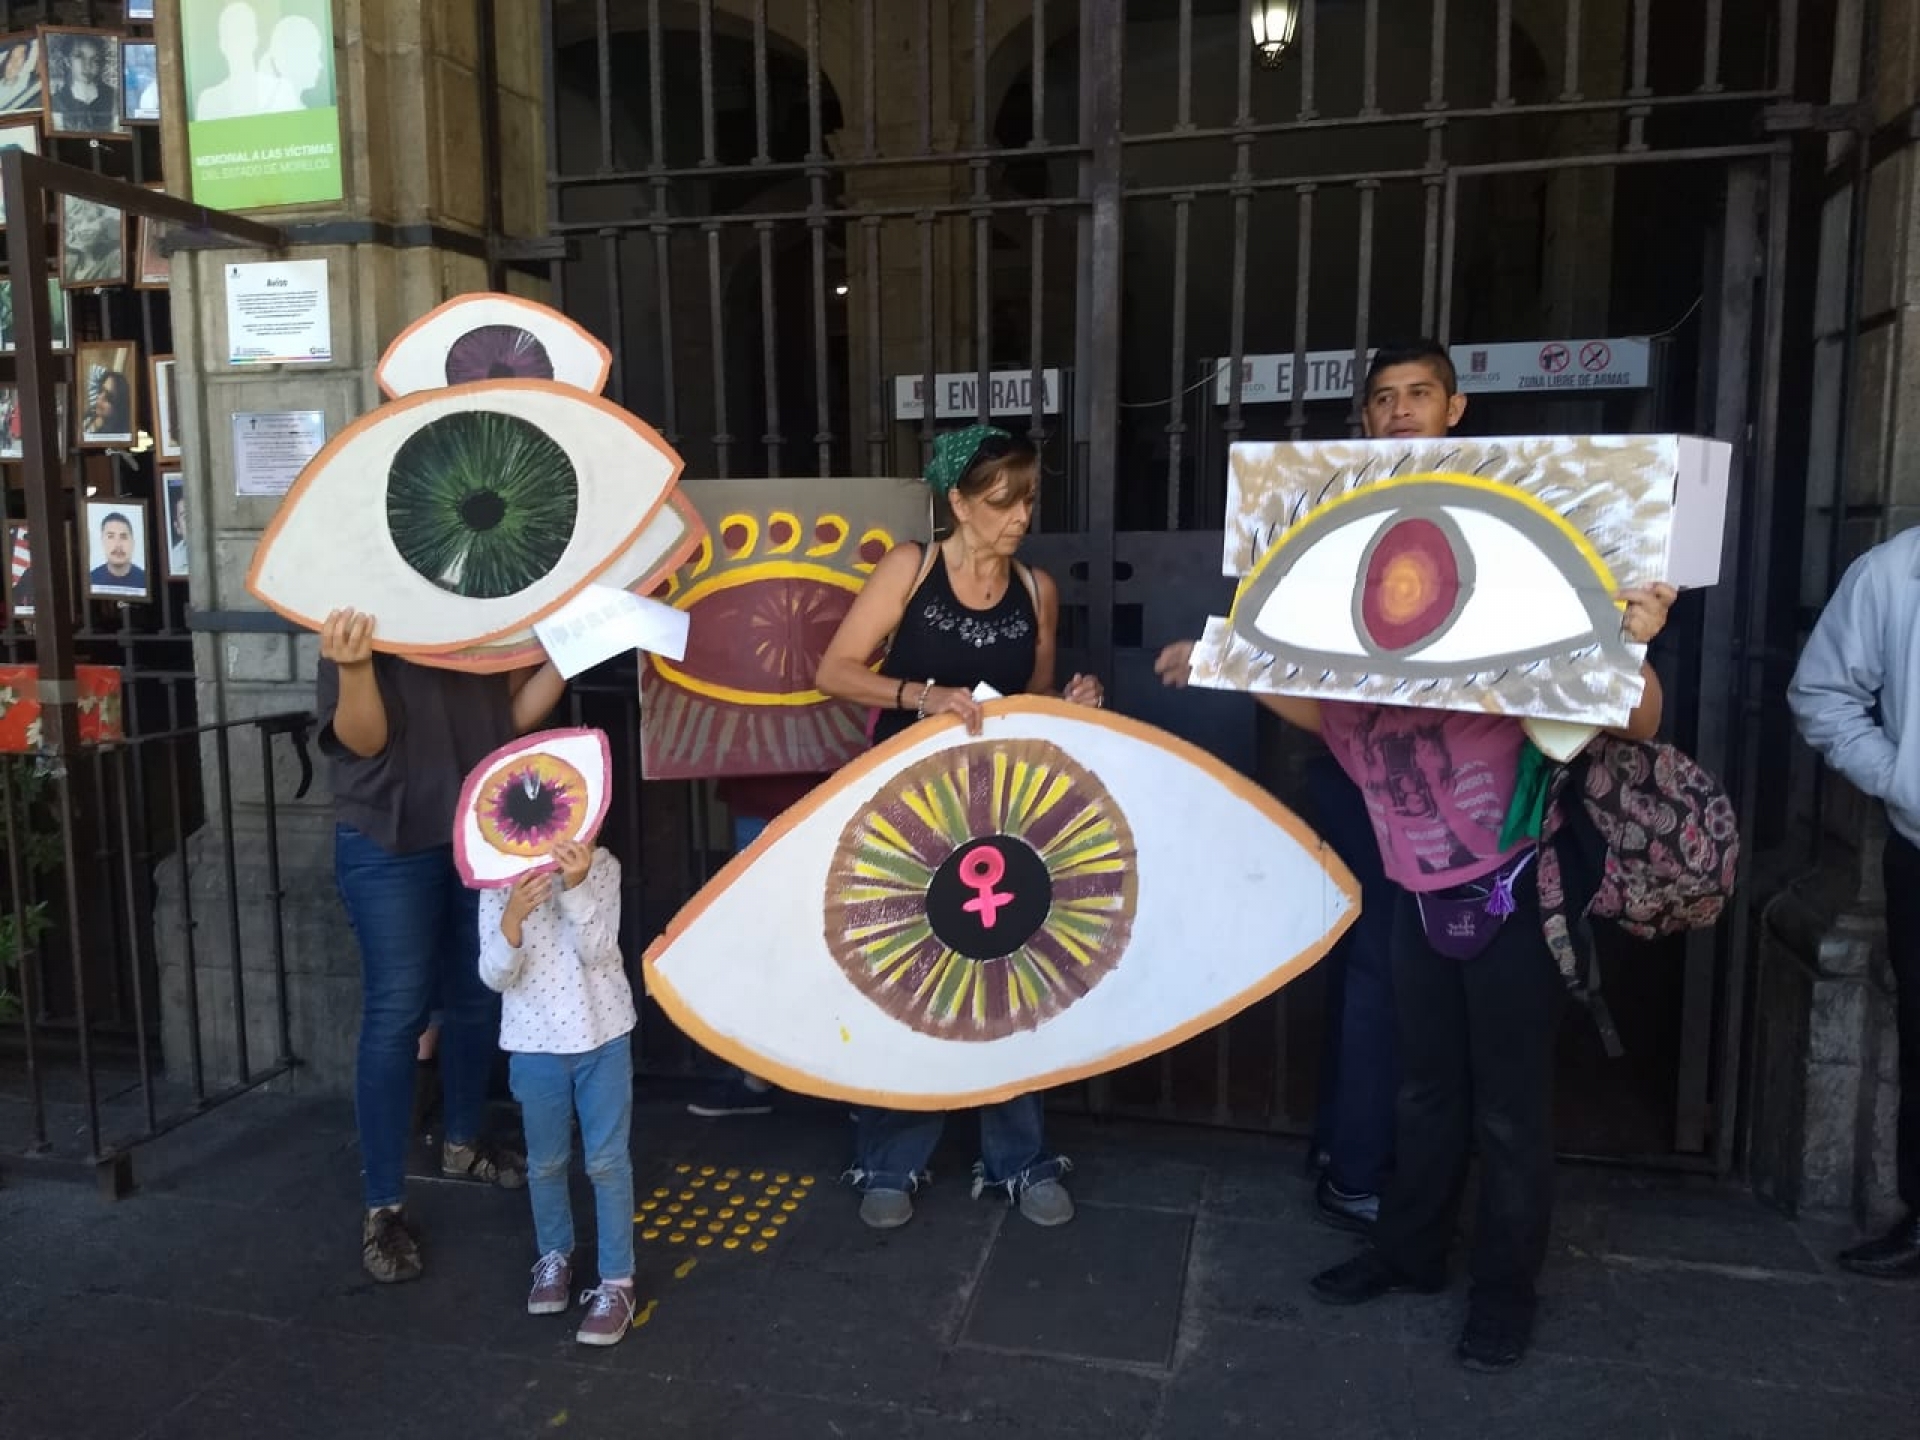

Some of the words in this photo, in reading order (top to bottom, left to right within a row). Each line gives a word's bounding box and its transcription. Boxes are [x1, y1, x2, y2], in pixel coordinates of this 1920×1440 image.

[195, 153, 250, 166] MEMORIAL
[261, 148, 282, 161] LAS
[284, 143, 334, 157] VÍCTIMAS
[1518, 375, 1545, 388] ZONA
[1547, 374, 1576, 387] LIBRE
[1578, 373, 1592, 386] DE
[1594, 371, 1630, 385] ARMAS
[948, 378, 1050, 411] ENRADA
